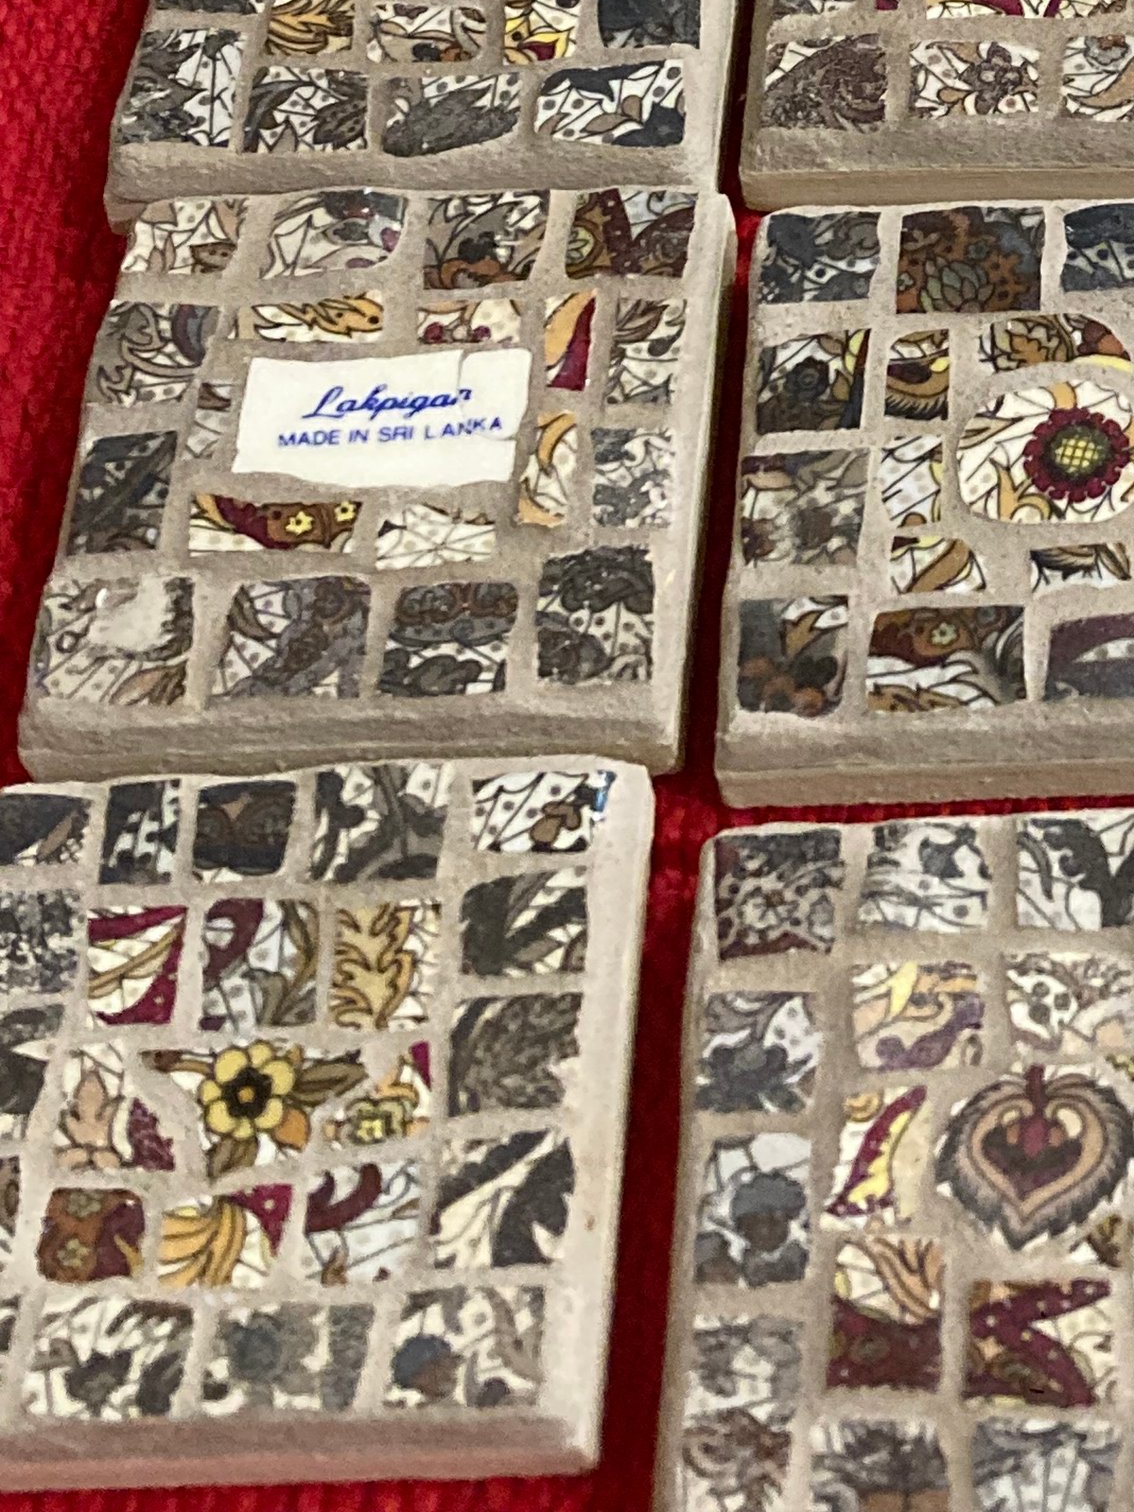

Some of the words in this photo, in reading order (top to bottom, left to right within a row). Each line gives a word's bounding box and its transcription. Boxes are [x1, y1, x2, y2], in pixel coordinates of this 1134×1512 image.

[301, 384, 473, 421] Lakpigan
[277, 429, 340, 448] MADE
[348, 428, 370, 444] IN
[377, 425, 414, 442] SRI
[424, 416, 503, 440] LANKA
